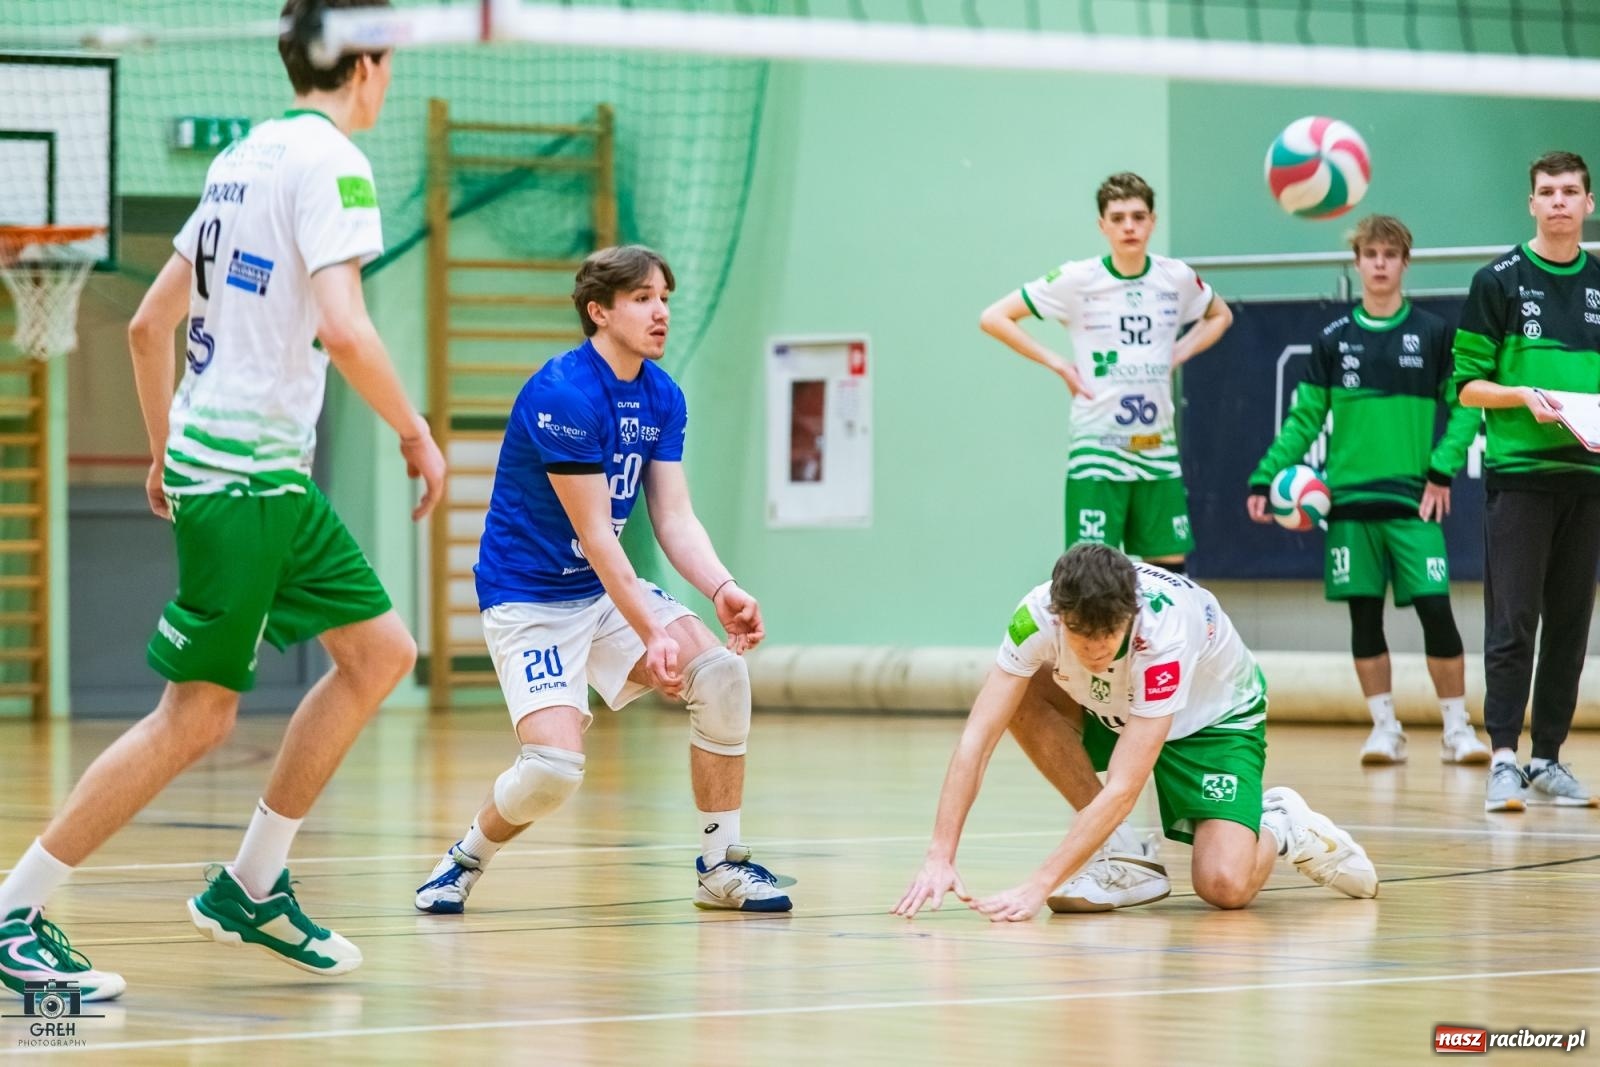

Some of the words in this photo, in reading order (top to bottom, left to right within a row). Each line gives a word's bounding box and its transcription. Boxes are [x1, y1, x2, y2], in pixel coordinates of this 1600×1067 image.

[1120, 315, 1152, 346] 52
[1079, 508, 1106, 538] 52
[523, 645, 563, 683] 20
[529, 681, 568, 693] CUTLINE
